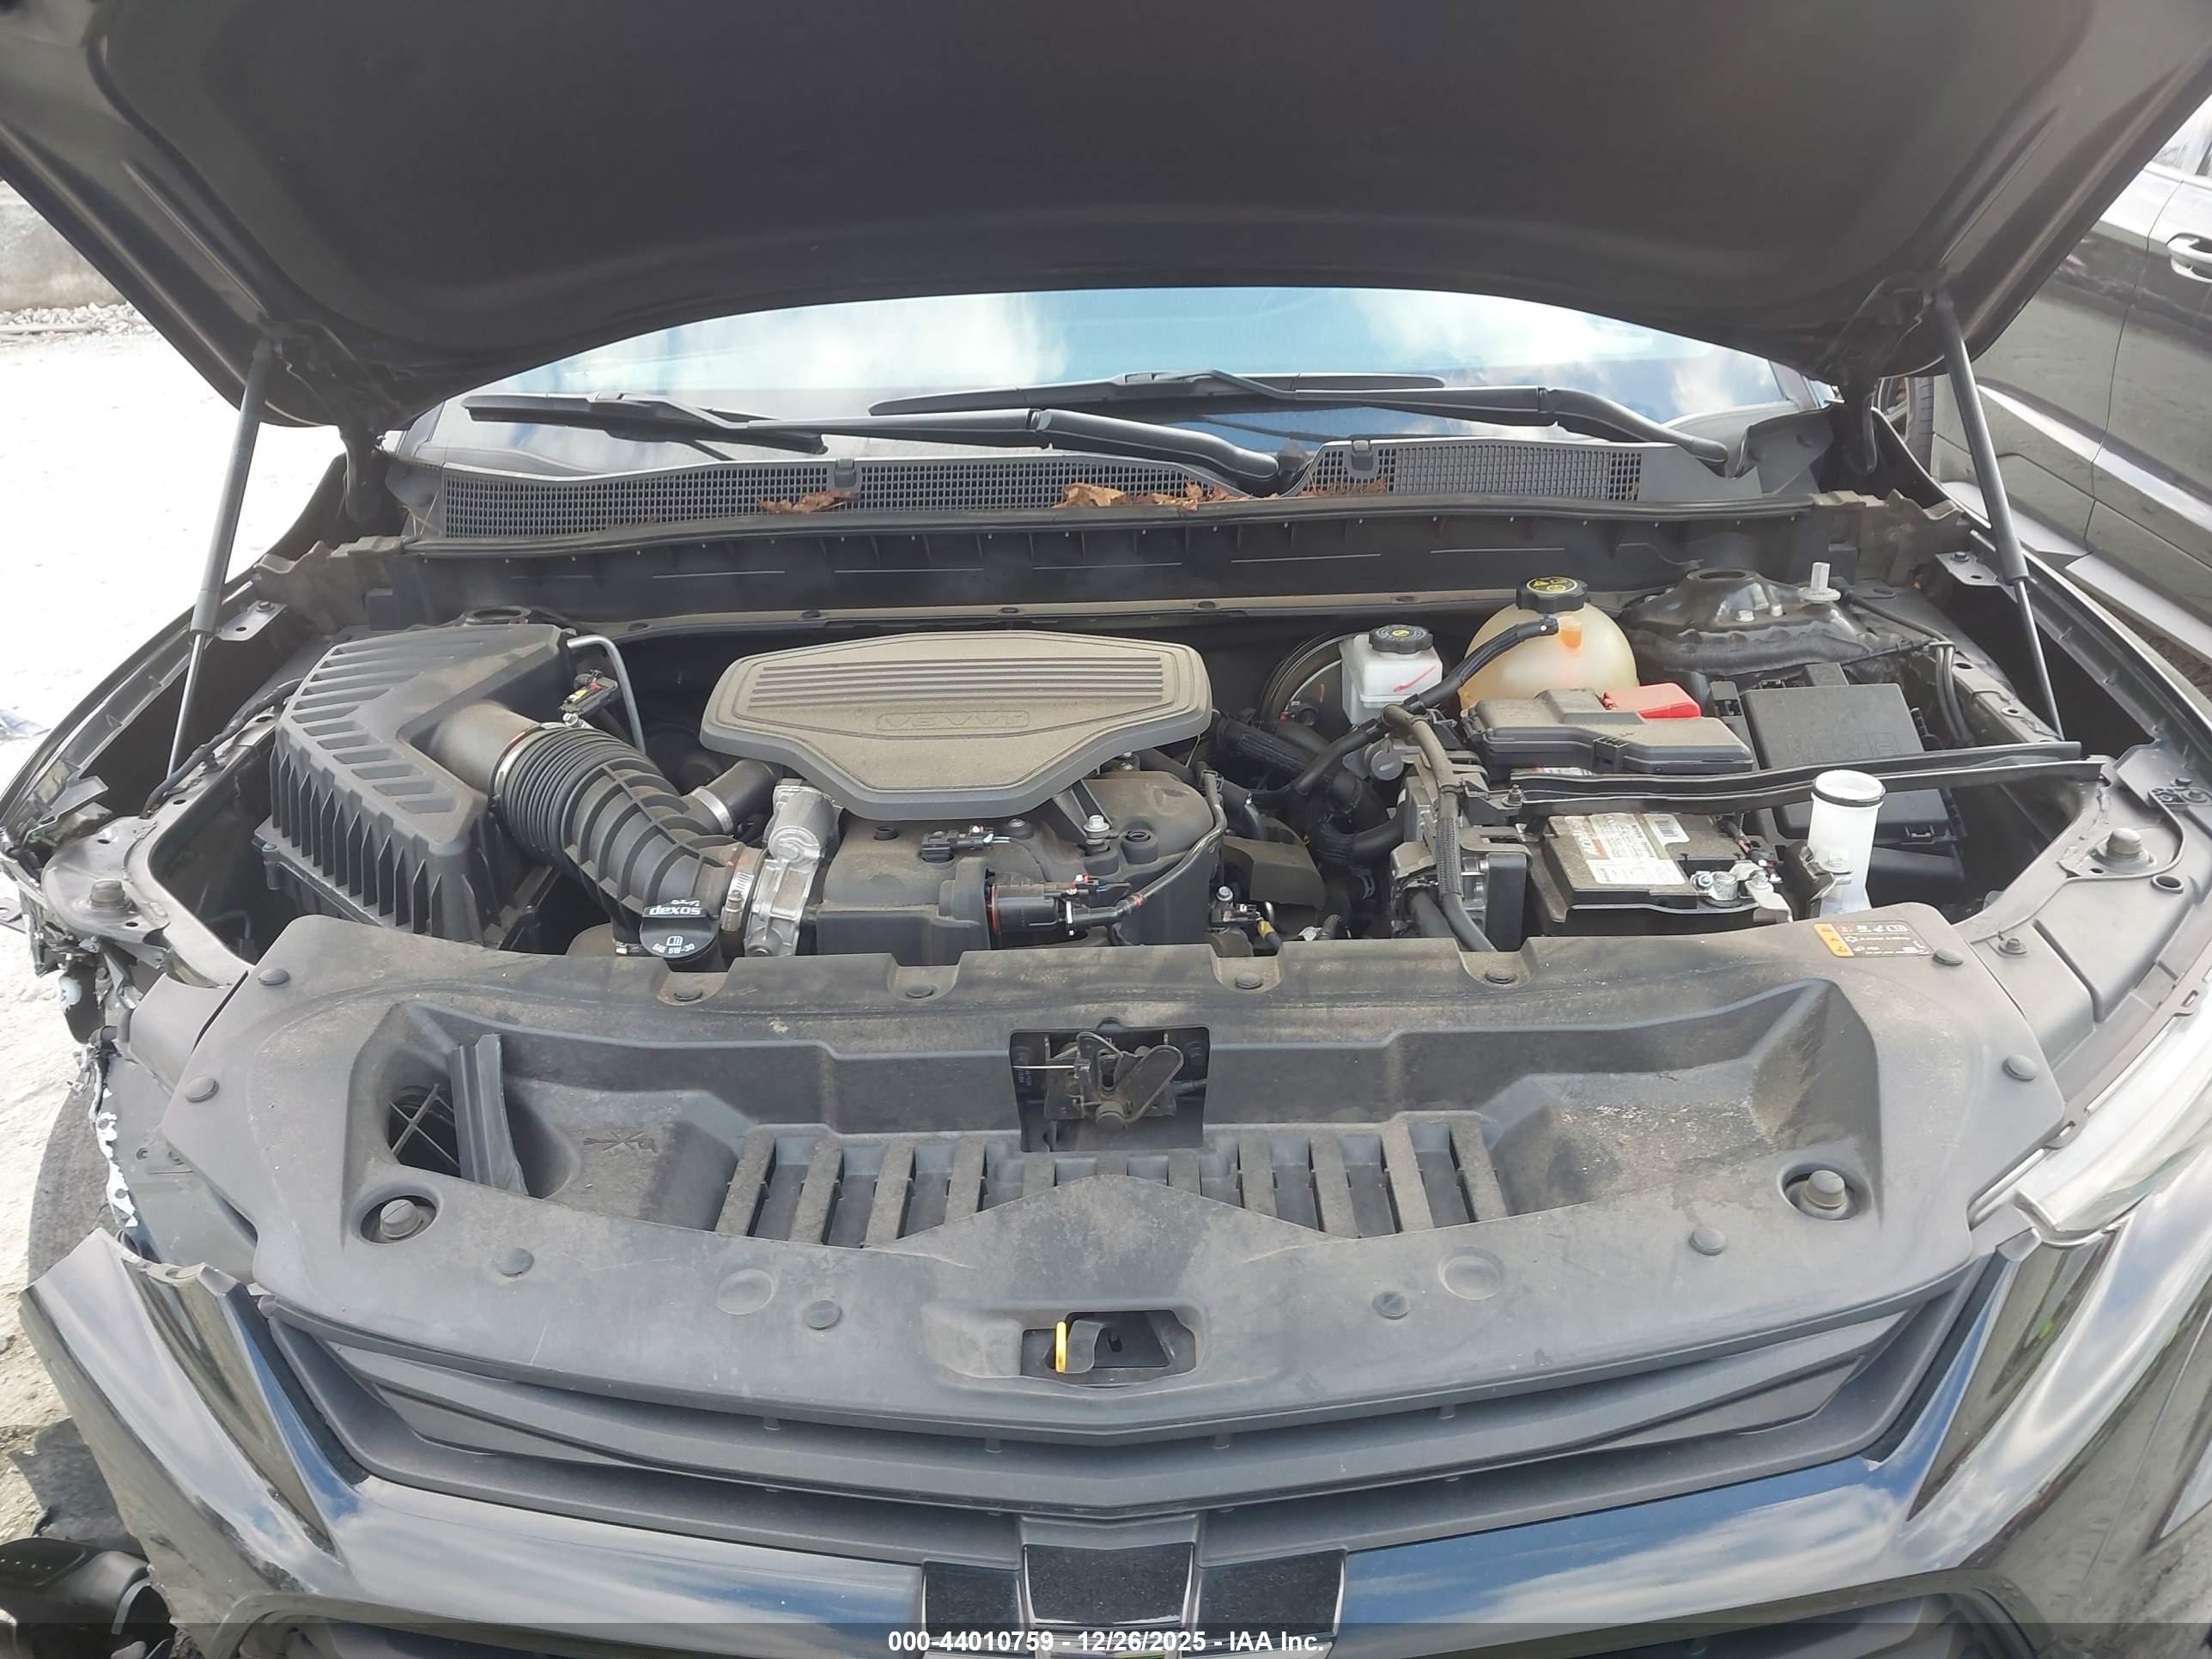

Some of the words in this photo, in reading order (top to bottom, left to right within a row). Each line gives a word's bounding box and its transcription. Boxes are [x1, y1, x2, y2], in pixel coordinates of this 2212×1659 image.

[649, 905, 702, 915] dexos
[653, 944, 666, 953] SAE
[668, 944, 695, 954] 5W-30
